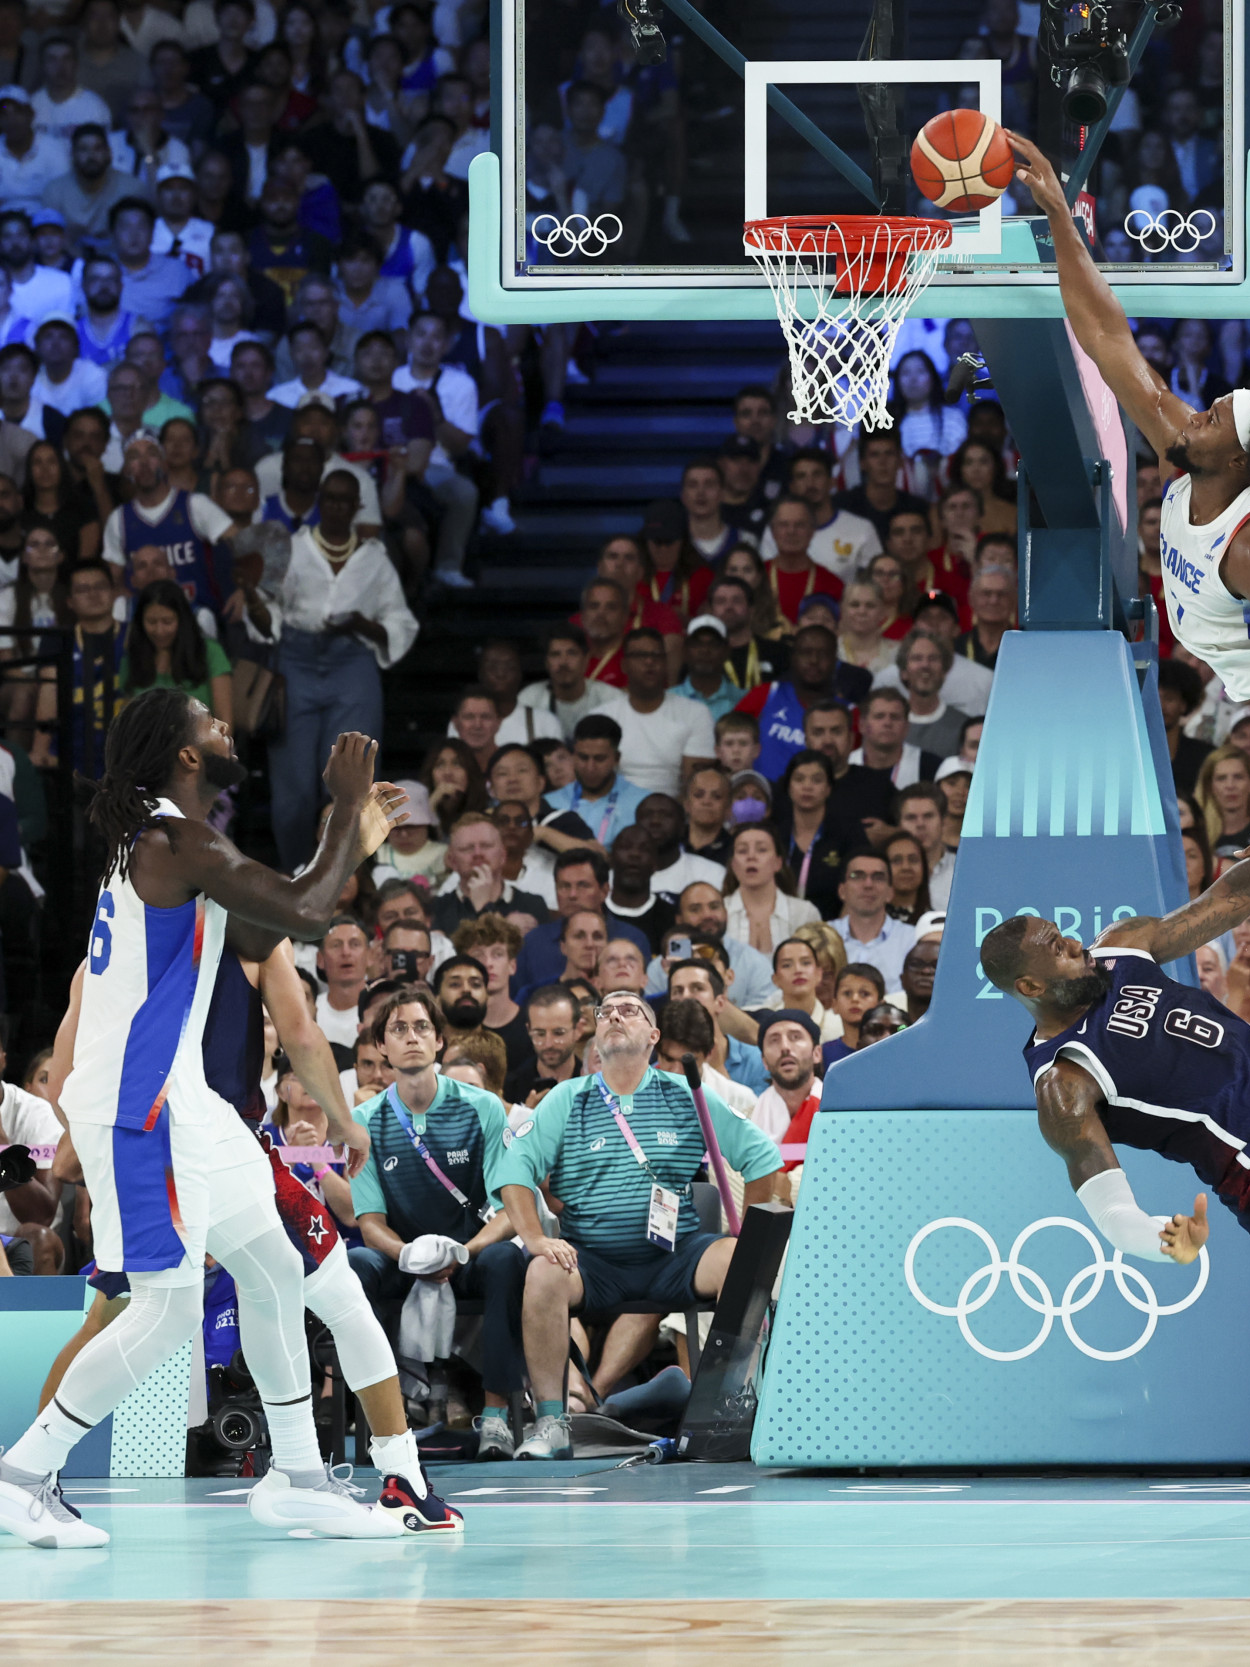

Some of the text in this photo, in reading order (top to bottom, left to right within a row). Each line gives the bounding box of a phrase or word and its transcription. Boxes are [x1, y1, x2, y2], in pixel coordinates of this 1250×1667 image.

[1160, 533, 1206, 594] RANCE
[90, 889, 115, 976] 6
[1106, 985, 1162, 1039] USA
[1164, 1008, 1225, 1048] 6
[446, 1149, 469, 1159] PARIS
[448, 1156, 470, 1165] 2024
